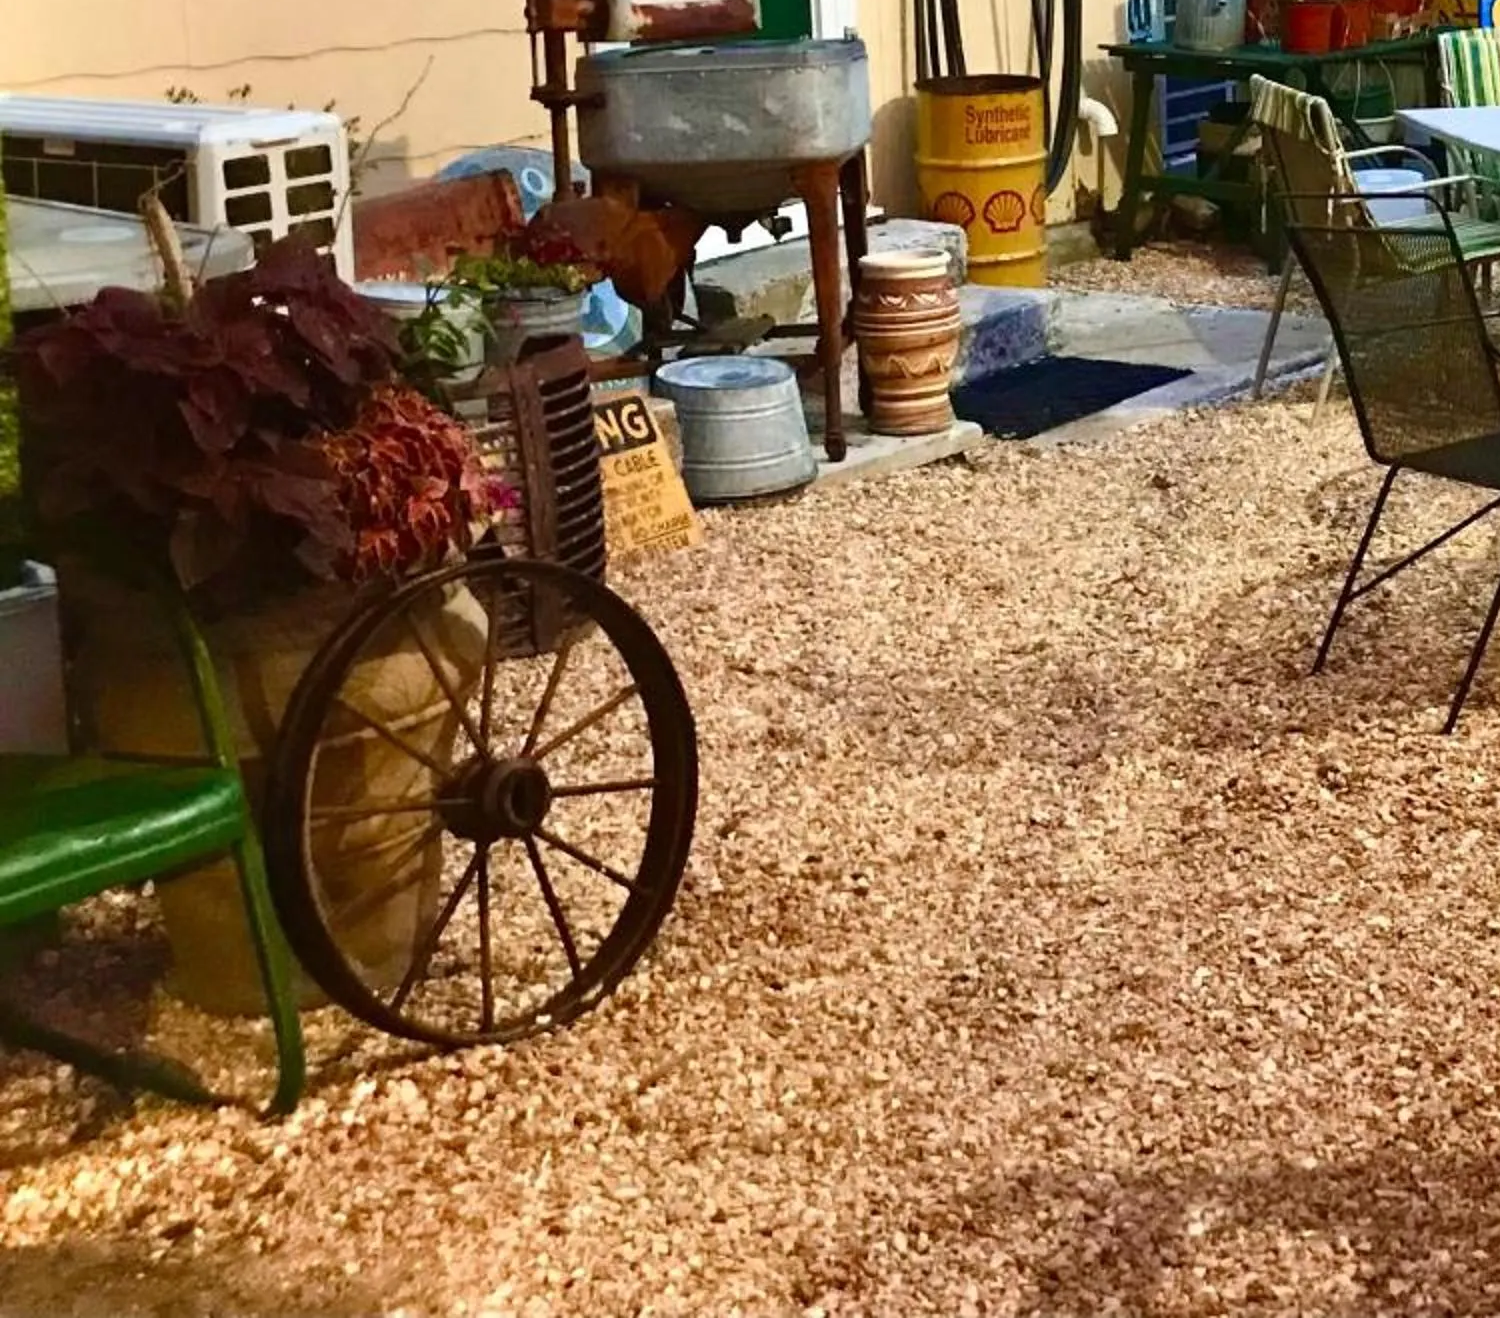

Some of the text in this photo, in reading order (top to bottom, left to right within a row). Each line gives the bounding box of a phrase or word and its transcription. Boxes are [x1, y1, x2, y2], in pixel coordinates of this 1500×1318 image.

[965, 104, 1030, 129] Synthetic
[965, 124, 1031, 145] Lubricant
[613, 450, 662, 477] CABLE
